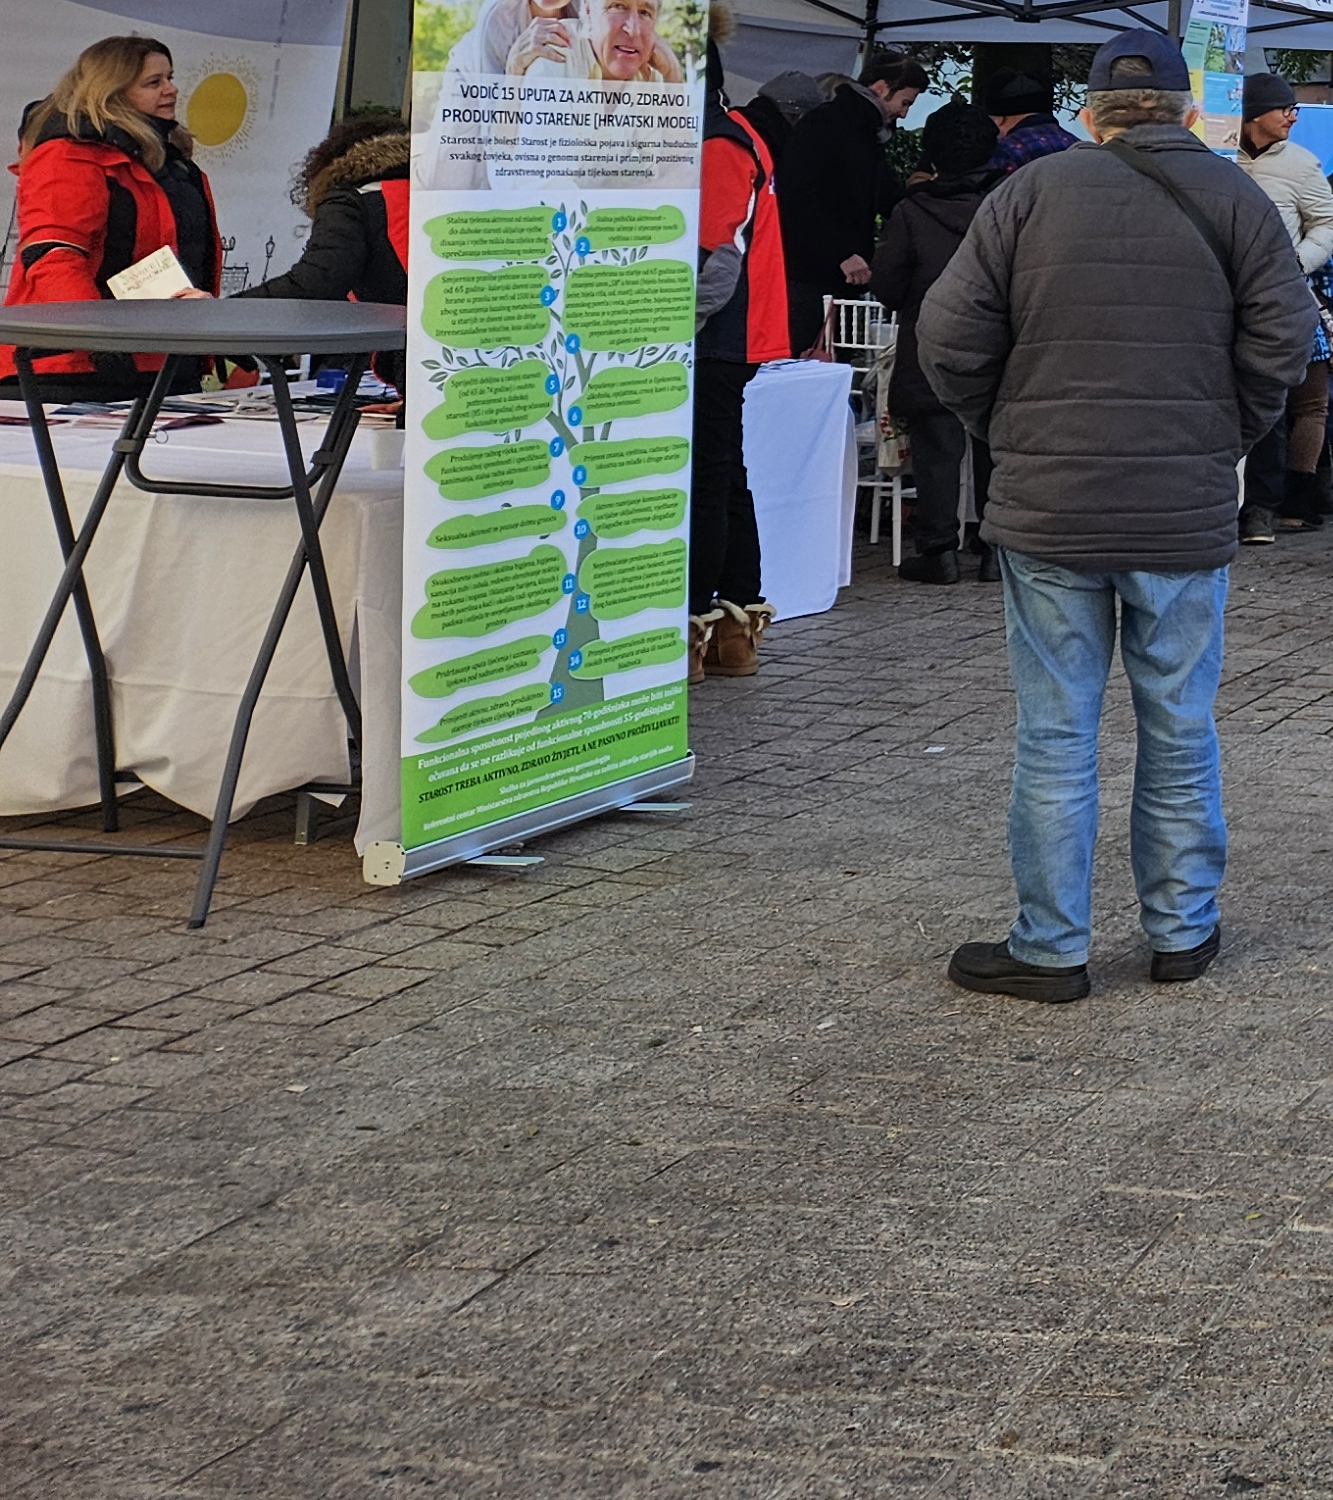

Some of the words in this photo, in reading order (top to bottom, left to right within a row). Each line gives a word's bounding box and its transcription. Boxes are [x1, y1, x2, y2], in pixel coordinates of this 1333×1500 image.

[460, 83, 500, 100] VODIČ
[501, 86, 515, 101] 15
[517, 87, 558, 102] UPUTA
[558, 89, 574, 103] ZA
[576, 90, 634, 107] AKTIVNO,
[636, 92, 684, 107] ZDRAVO
[686, 94, 691, 107] I
[442, 109, 533, 125] PRODUKTIVNO
[535, 112, 591, 126] STARENJE
[593, 113, 654, 130] [HRVATSKI
[657, 115, 699, 132] MODEL]
[440, 135, 476, 145] Starost
[521, 137, 548, 146] Starost
[599, 139, 626, 149] pojava
[449, 151, 482, 163] svakog
[556, 218, 562, 226] 1
[580, 242, 587, 251] 2
[544, 292, 550, 300] 3
[569, 339, 576, 348] 4
[549, 380, 555, 389] 5
[571, 412, 578, 421] 6
[576, 525, 586, 535] 10
[565, 579, 573, 589] 11
[576, 600, 586, 609] 12
[555, 634, 565, 644] 13
[552, 688, 562, 698] 15
[418, 782, 454, 803] STAROST
[454, 774, 482, 792] TREBA
[482, 764, 520, 784] AKTIVNO,
[520, 753, 551, 772] ZDRAVO
